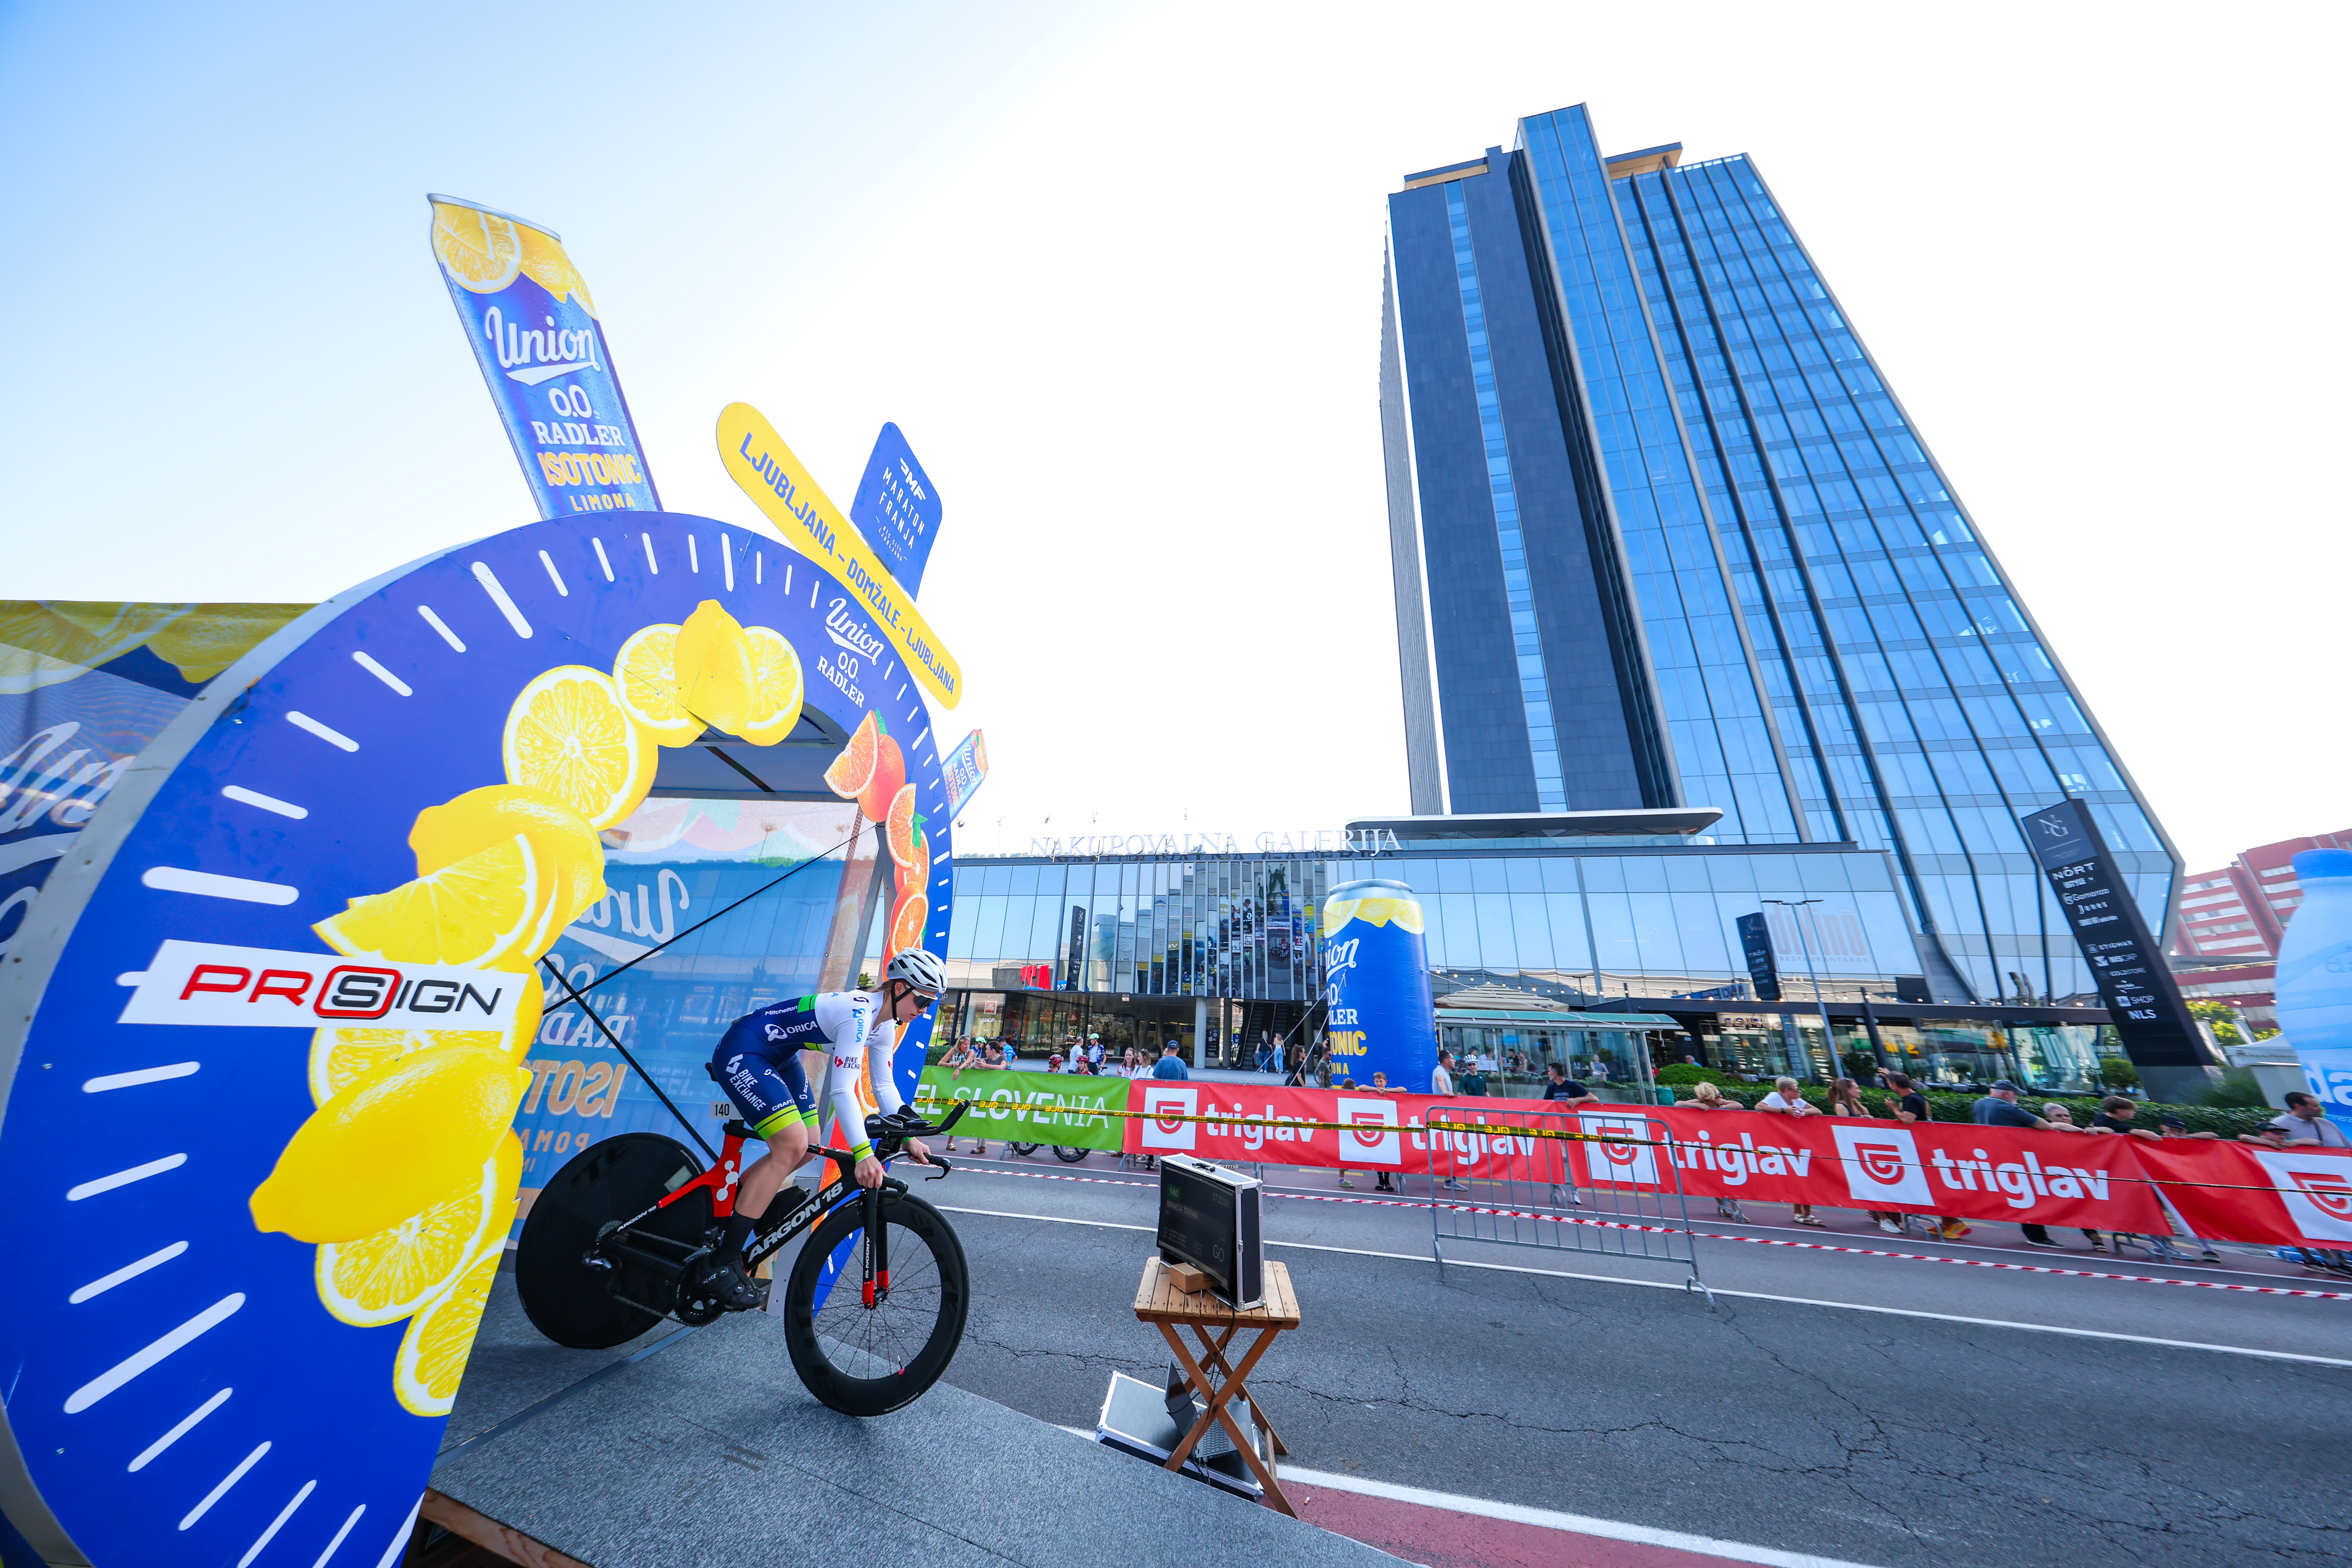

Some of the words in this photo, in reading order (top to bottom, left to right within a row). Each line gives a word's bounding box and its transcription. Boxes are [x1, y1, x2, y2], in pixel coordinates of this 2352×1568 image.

[486, 307, 601, 372] Union
[531, 422, 626, 446] RADLER
[537, 452, 641, 487] ISOTONIC
[570, 494, 635, 512] LIMONA
[883, 466, 925, 535] MARATON
[879, 491, 914, 549] FRANJA
[878, 528, 902, 561] LJUBLJANA
[892, 539, 902, 553] CITY
[739, 432, 837, 557] LJUBLJANA
[846, 557, 901, 631] DOMŽALE
[906, 631, 955, 695] LJUBLJANA
[826, 598, 884, 666] Union
[817, 655, 864, 708] RADLER
[962, 744, 977, 786] Union
[953, 762, 964, 800] RADLER
[1028, 832, 1240, 857] NAKUPOVALNA
[1255, 828, 1403, 857] GALERIJA
[1325, 938, 1359, 968] ion
[765, 1005, 797, 1016] Mitchelton
[986, 1003, 995, 1013] illy
[2127, 1009, 2157, 1020] NLS
[2129, 996, 2154, 1004] SHOP
[786, 1021, 817, 1034] ORICA
[855, 1018, 864, 1042] ORICA
[730, 1074, 767, 1111] EXCHANGE
[738, 1069, 758, 1088] BIKE
[715, 1103, 730, 1116] 140
[772, 1099, 792, 1111] CRAFT
[952, 1087, 1109, 1129] SLOVENIA
[1205, 1103, 1317, 1150] triglav
[1410, 1108, 1535, 1165] triglav
[1662, 1130, 1812, 1186] triglav
[1170, 1187, 1178, 1198] 140
[1931, 1148, 2109, 1209] triglav
[617, 1210, 647, 1232] ARGON
[748, 1198, 821, 1263] ARGON
[821, 1182, 843, 1202] 18
[1167, 1200, 1183, 1212] MANCA
[1183, 1207, 1198, 1220] TERAN
[1213, 1244, 1224, 1262] GO
[706, 1273, 717, 1283] LAKE
